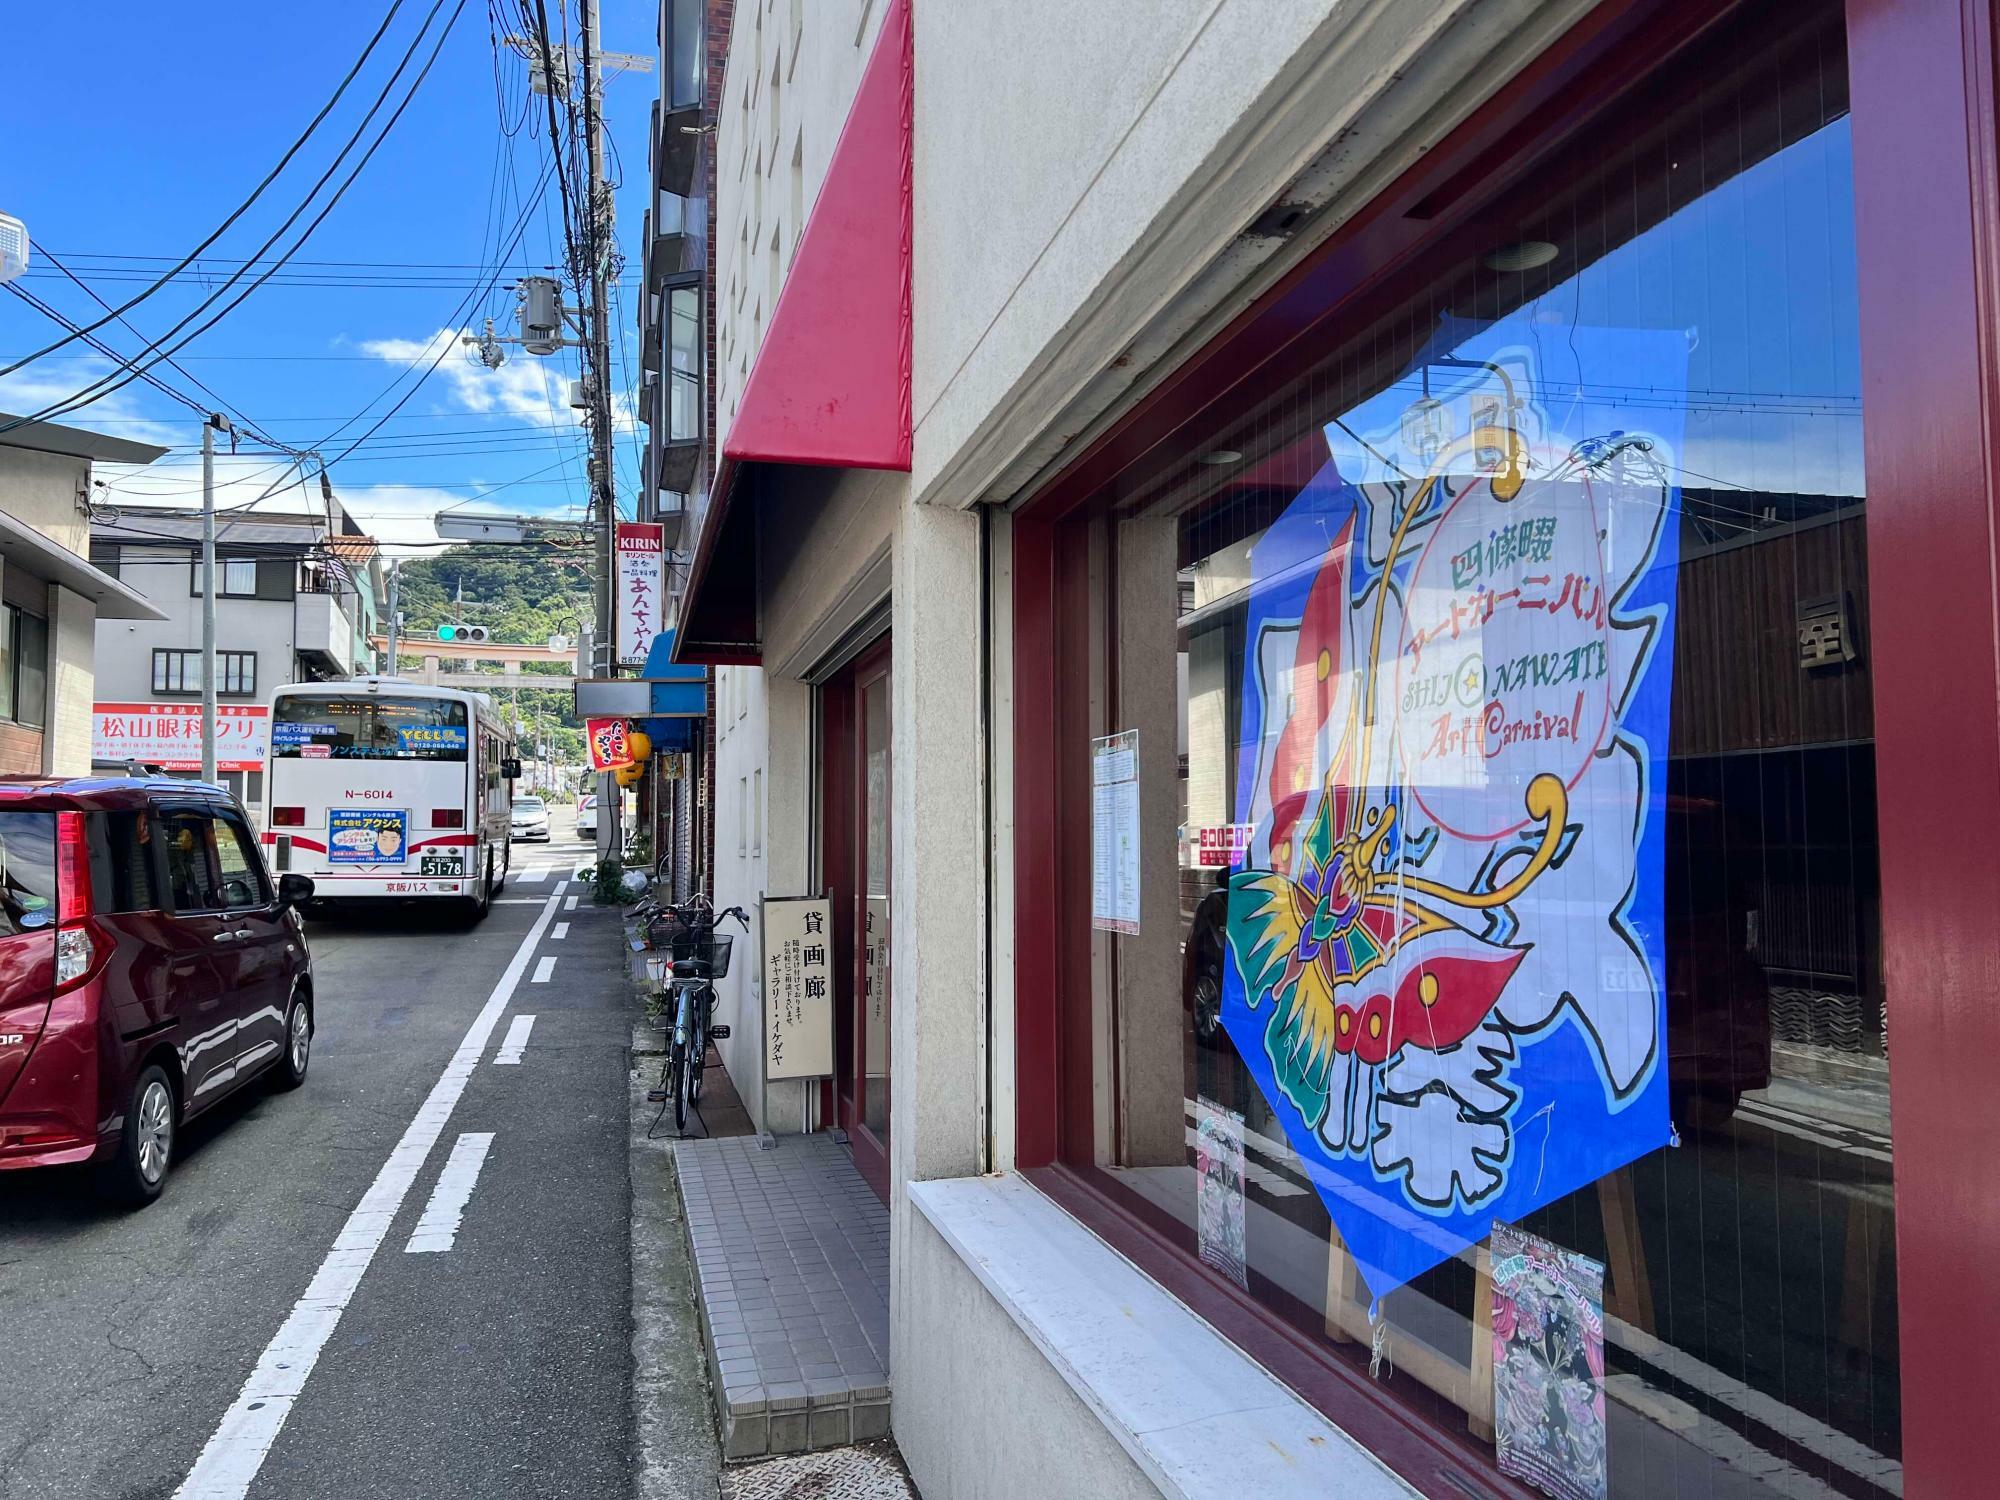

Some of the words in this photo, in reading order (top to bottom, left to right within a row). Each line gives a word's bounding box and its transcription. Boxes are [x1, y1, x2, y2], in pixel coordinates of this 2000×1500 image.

[620, 537, 660, 550] KIRIN
[622, 569, 658, 577] 一品料理
[1421, 710, 1473, 761] Art
[1478, 690, 1584, 762] Carnival
[401, 729, 442, 741] YELL
[165, 761, 203, 770] Matsuyam
[221, 761, 241, 769] Clinic
[345, 790, 393, 799] N-6014
[363, 818, 402, 828] アクシス
[427, 863, 462, 875] 51-78
[385, 882, 428, 892] 京阪バス
[802, 911, 826, 1000] 貸画廊
[770, 954, 783, 1066] ギャラリー・イケダヤ
